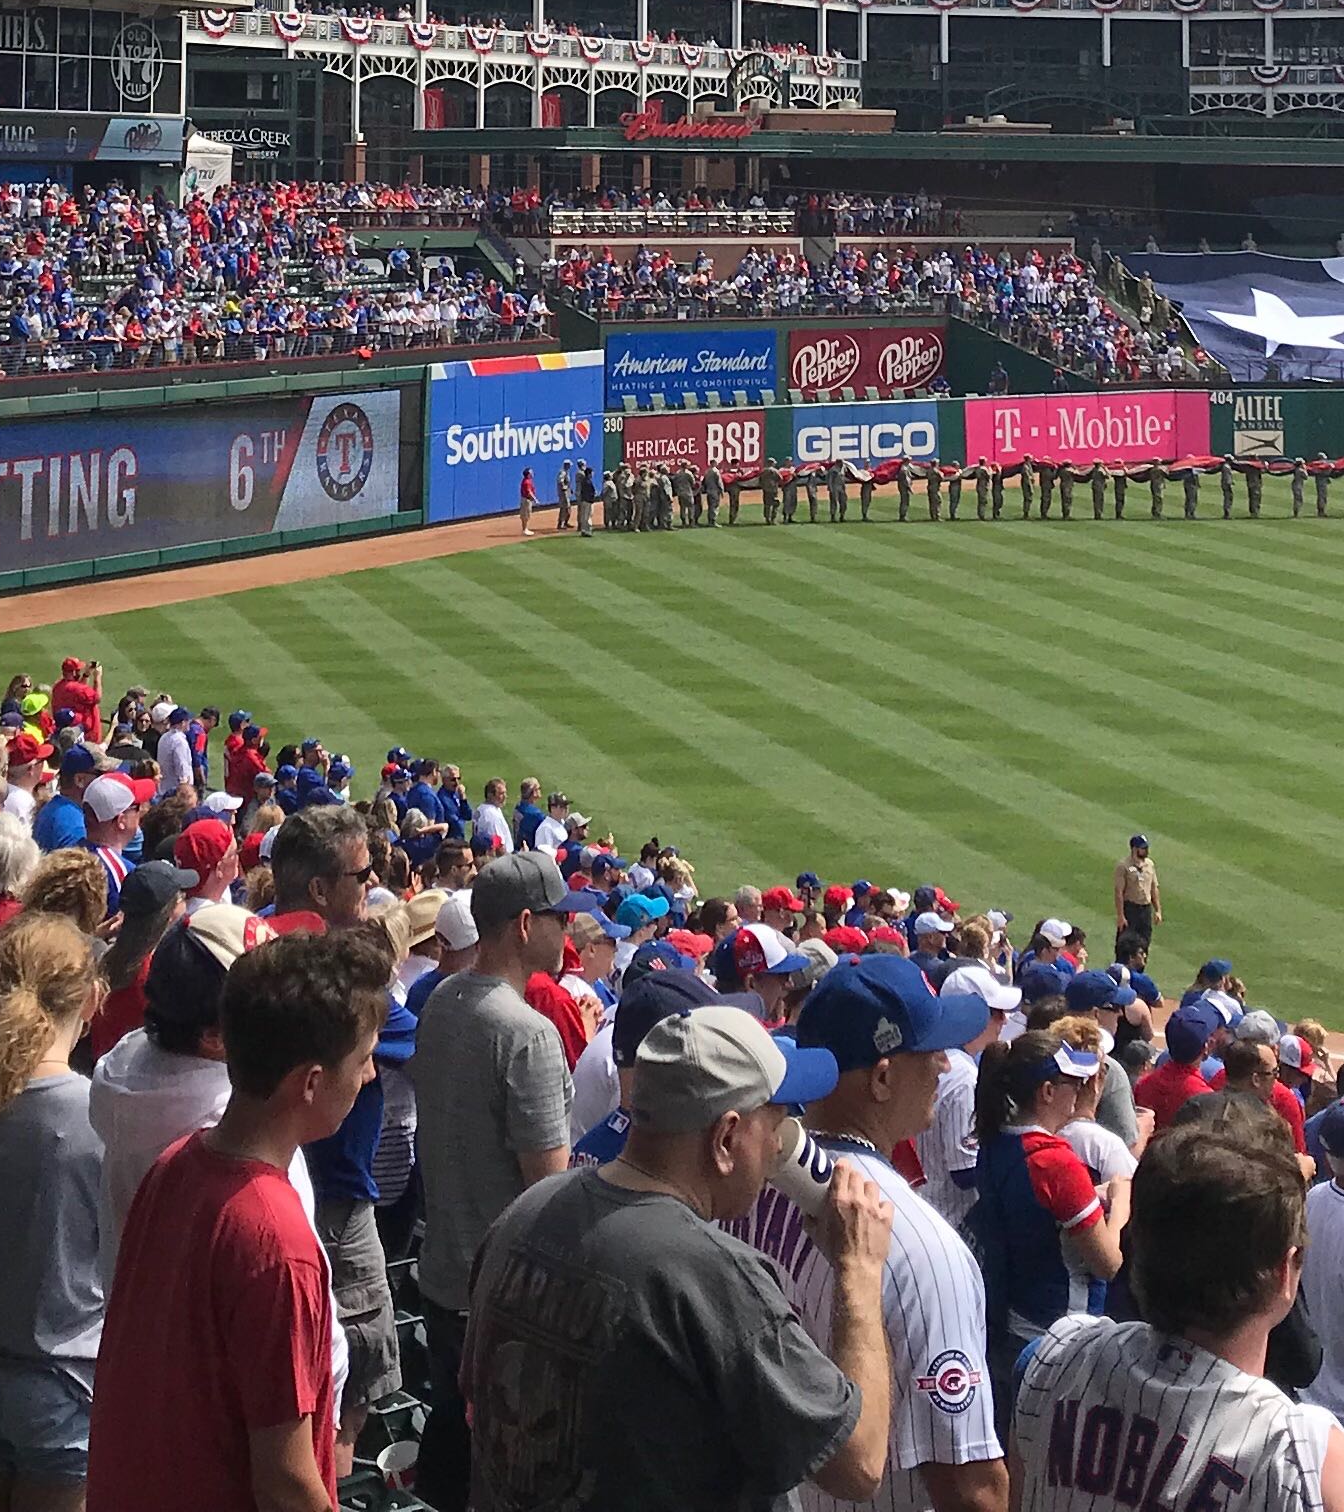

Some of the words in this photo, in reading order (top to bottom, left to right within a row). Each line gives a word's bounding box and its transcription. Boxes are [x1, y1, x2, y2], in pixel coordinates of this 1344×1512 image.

[126, 29, 149, 43] OLD
[125, 81, 149, 96] CLUB
[248, 128, 291, 148] CREEK
[246, 150, 280, 160] WHISKEY
[816, 337, 841, 360] Dr
[902, 336, 925, 358] Dr
[612, 348, 688, 377] American
[691, 346, 770, 374] Standard
[799, 343, 856, 389] Pepper
[885, 341, 940, 386] Pepper
[673, 381, 690, 389] AIR
[695, 377, 768, 388] CONDITIONING
[1209, 391, 1234, 406] 404
[1233, 394, 1284, 422] ALTEC
[603, 416, 624, 433] 390
[1233, 420, 1285, 431] LANSING
[446, 415, 575, 466] Southwest
[706, 421, 761, 464] BSB
[797, 421, 936, 462] GEICO
